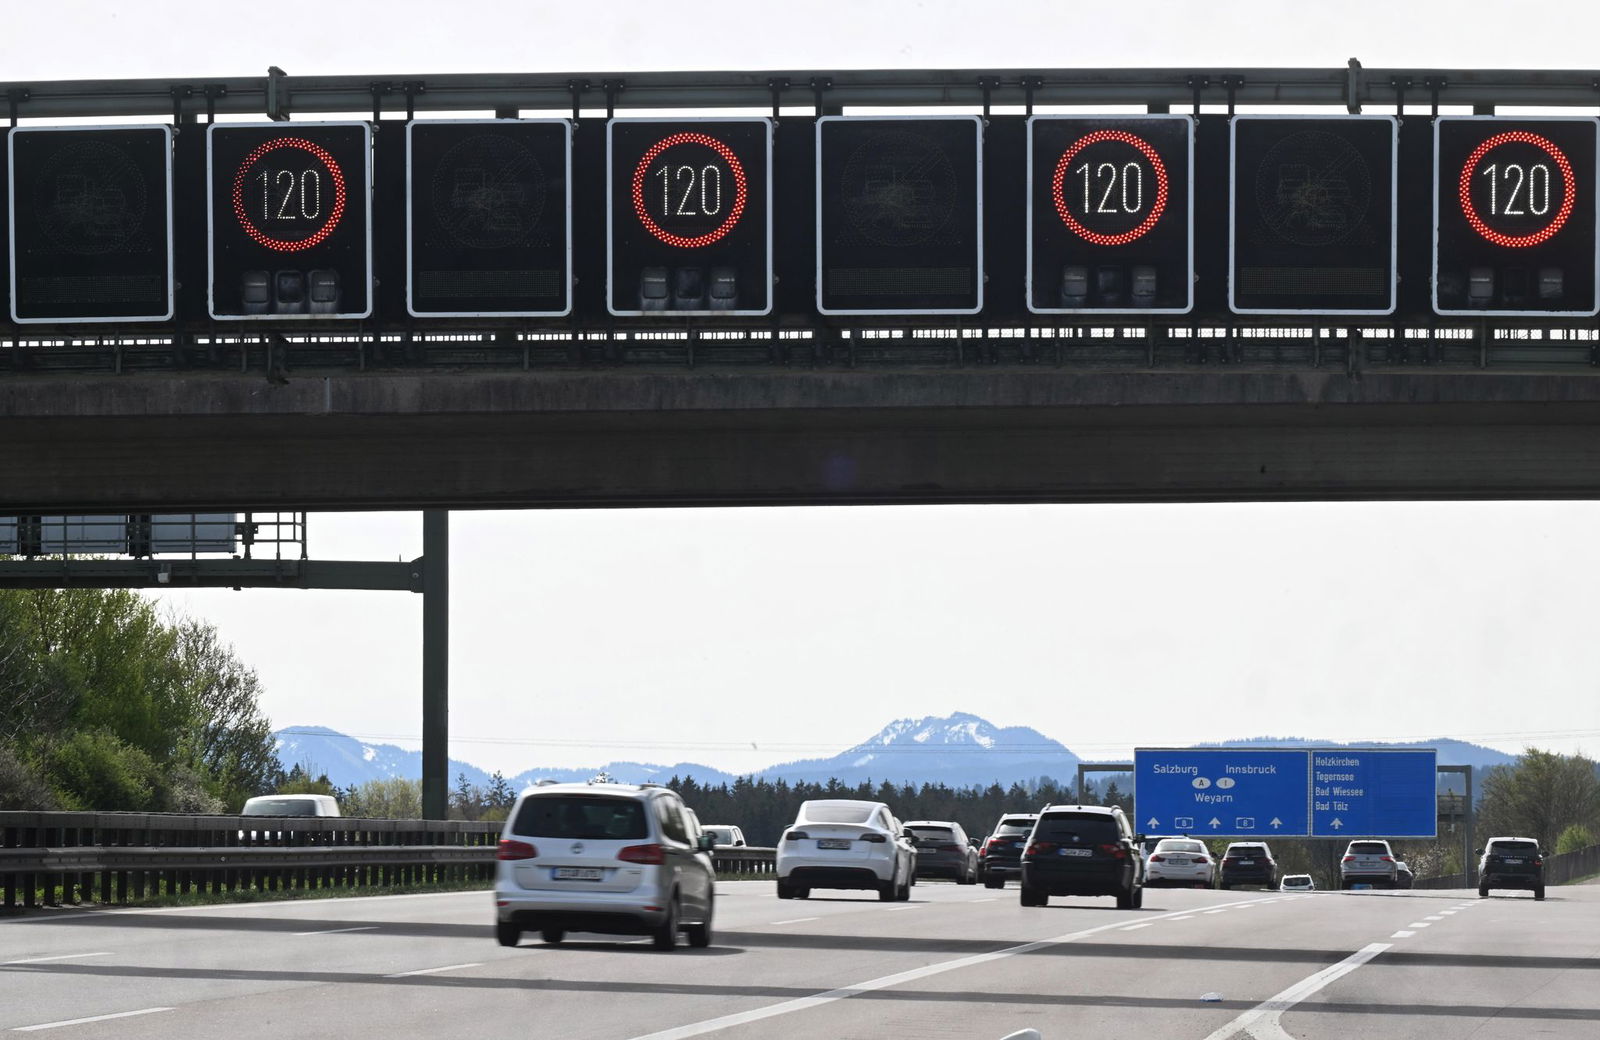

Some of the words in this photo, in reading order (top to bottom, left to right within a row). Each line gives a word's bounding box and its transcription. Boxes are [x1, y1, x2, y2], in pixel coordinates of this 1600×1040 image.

[656, 165, 720, 215] 120
[1077, 162, 1142, 213] 120
[1483, 164, 1549, 215] 120
[257, 170, 319, 219] 120
[1315, 757, 1360, 766] Holzkirchen
[1153, 764, 1198, 776] Salzburg
[1225, 764, 1277, 774] Innsbruck
[1316, 771, 1354, 783] Tegernsee
[1315, 786, 1329, 796] Bad
[1333, 786, 1364, 796] Wiessee
[1194, 793, 1233, 804] Weyarn
[1315, 801, 1329, 811] Bad
[1333, 801, 1348, 811] Tölz
